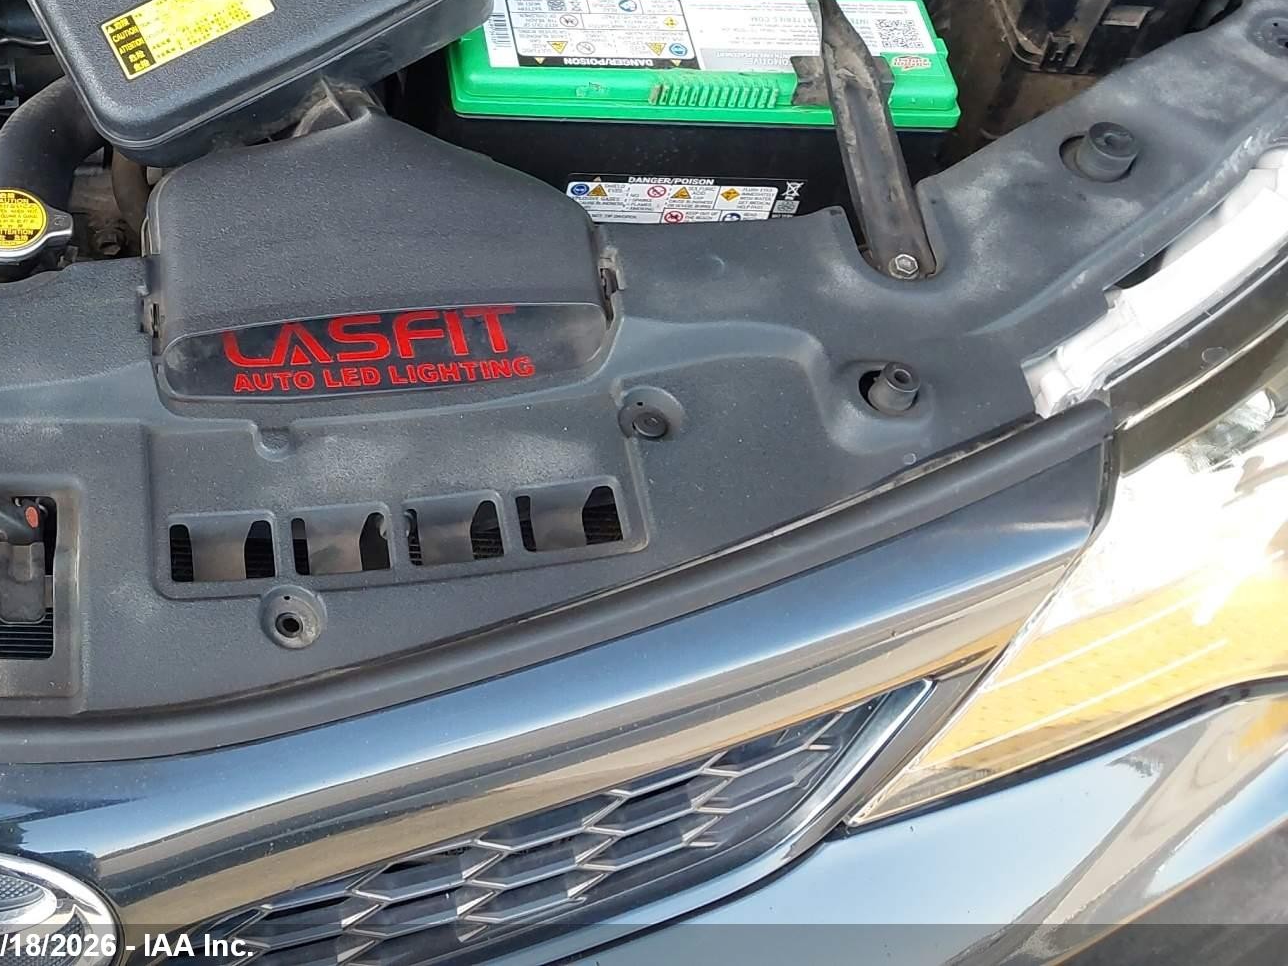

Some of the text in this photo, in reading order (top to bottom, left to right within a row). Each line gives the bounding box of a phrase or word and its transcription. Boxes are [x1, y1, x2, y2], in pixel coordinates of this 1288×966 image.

[627, 176, 715, 186] DANGER/POISON
[220, 306, 516, 368] LASFIT
[233, 356, 537, 393] AUTO LED LIGHTING
